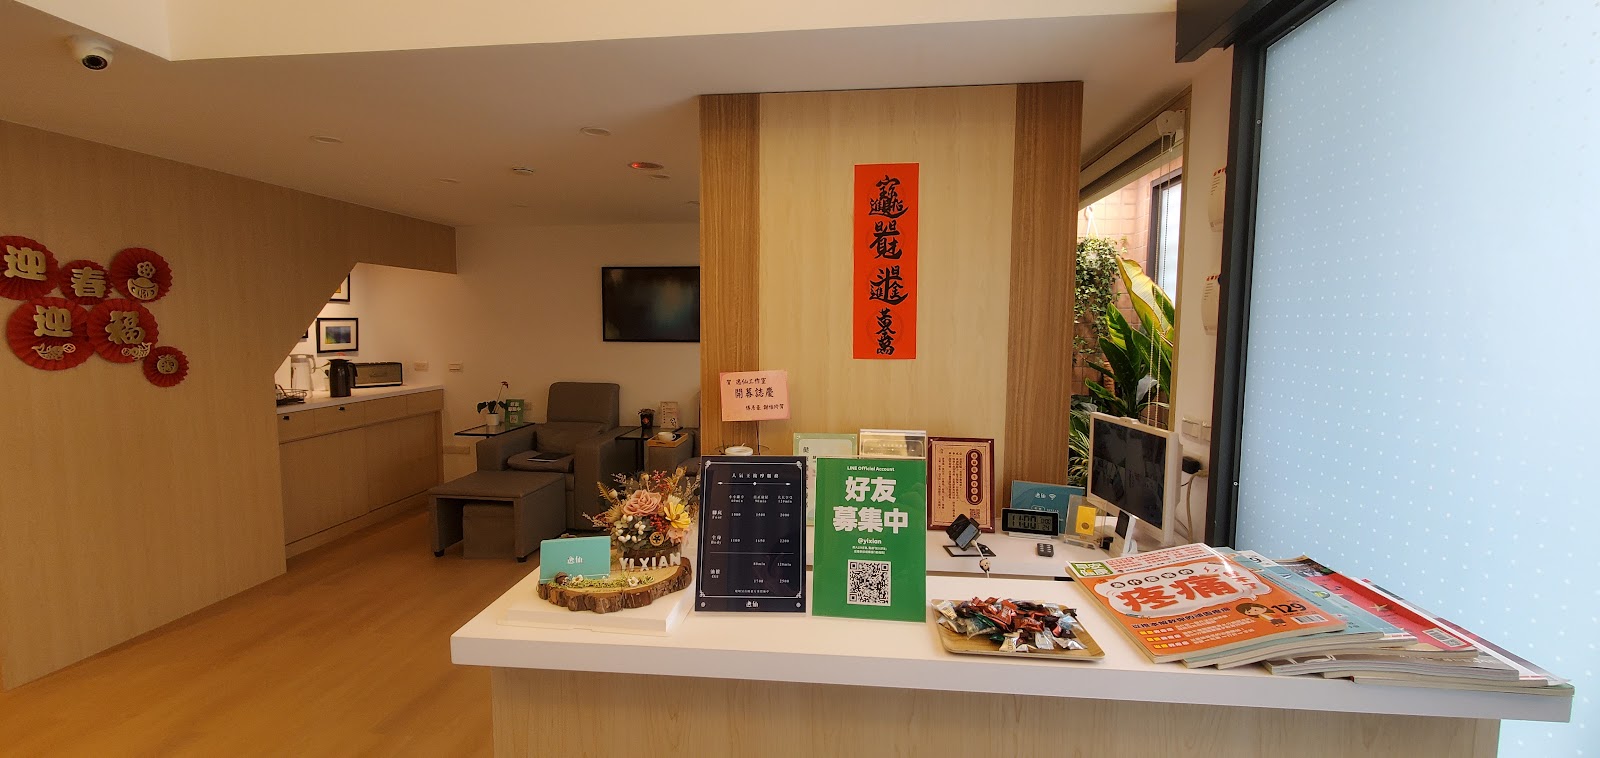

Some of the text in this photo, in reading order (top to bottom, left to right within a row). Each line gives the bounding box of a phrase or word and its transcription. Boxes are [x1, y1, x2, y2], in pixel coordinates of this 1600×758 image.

[735, 387, 774, 399] 開幕誌慶
[845, 475, 897, 503] 好友
[832, 506, 909, 534] 募集中
[857, 537, 882, 545] @yixian
[1116, 574, 1239, 612] 疼痛
[1271, 602, 1307, 614] 129
